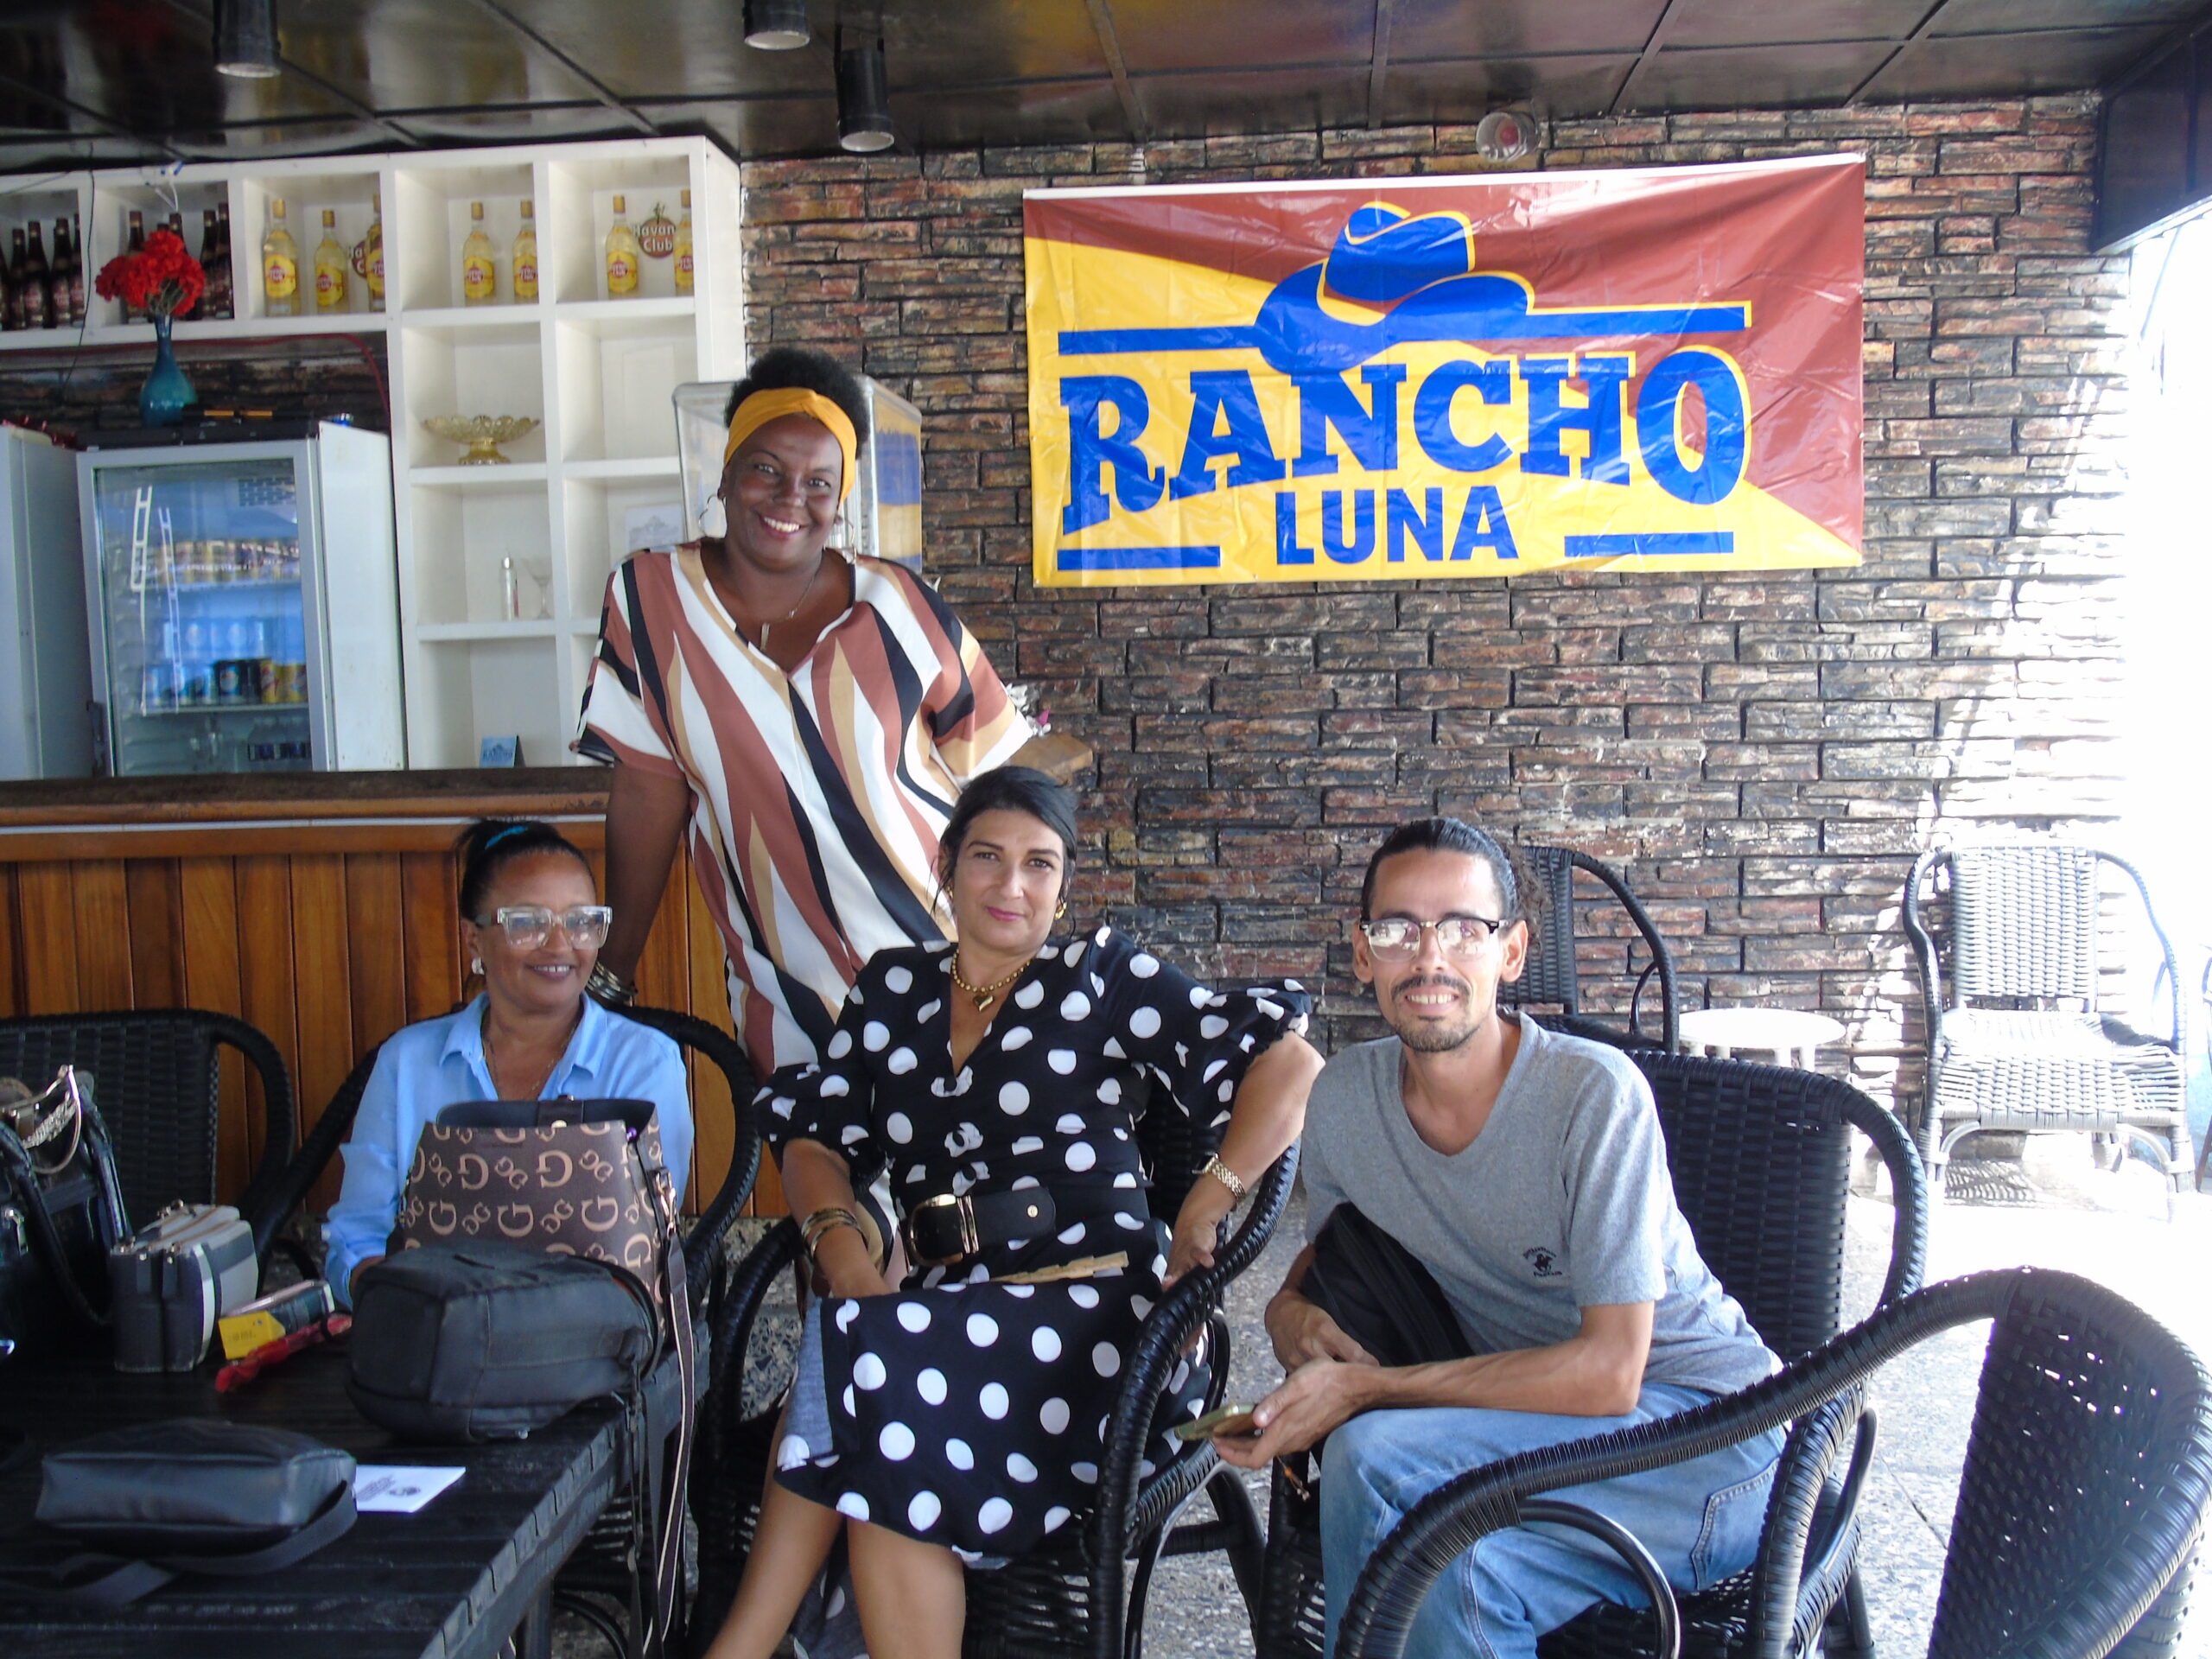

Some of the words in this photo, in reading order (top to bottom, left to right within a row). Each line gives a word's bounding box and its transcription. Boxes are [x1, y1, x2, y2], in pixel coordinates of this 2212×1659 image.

[632, 223, 677, 237] Havan
[643, 238, 673, 252] Club
[1058, 346, 1751, 536] RANCHO
[1275, 485, 1518, 566] LUNA
[458, 1153, 489, 1191] G
[537, 1149, 573, 1189] G
[429, 1198, 457, 1236] G
[497, 1201, 534, 1238] G
[581, 1194, 619, 1232] G
[624, 1232, 652, 1268] G
